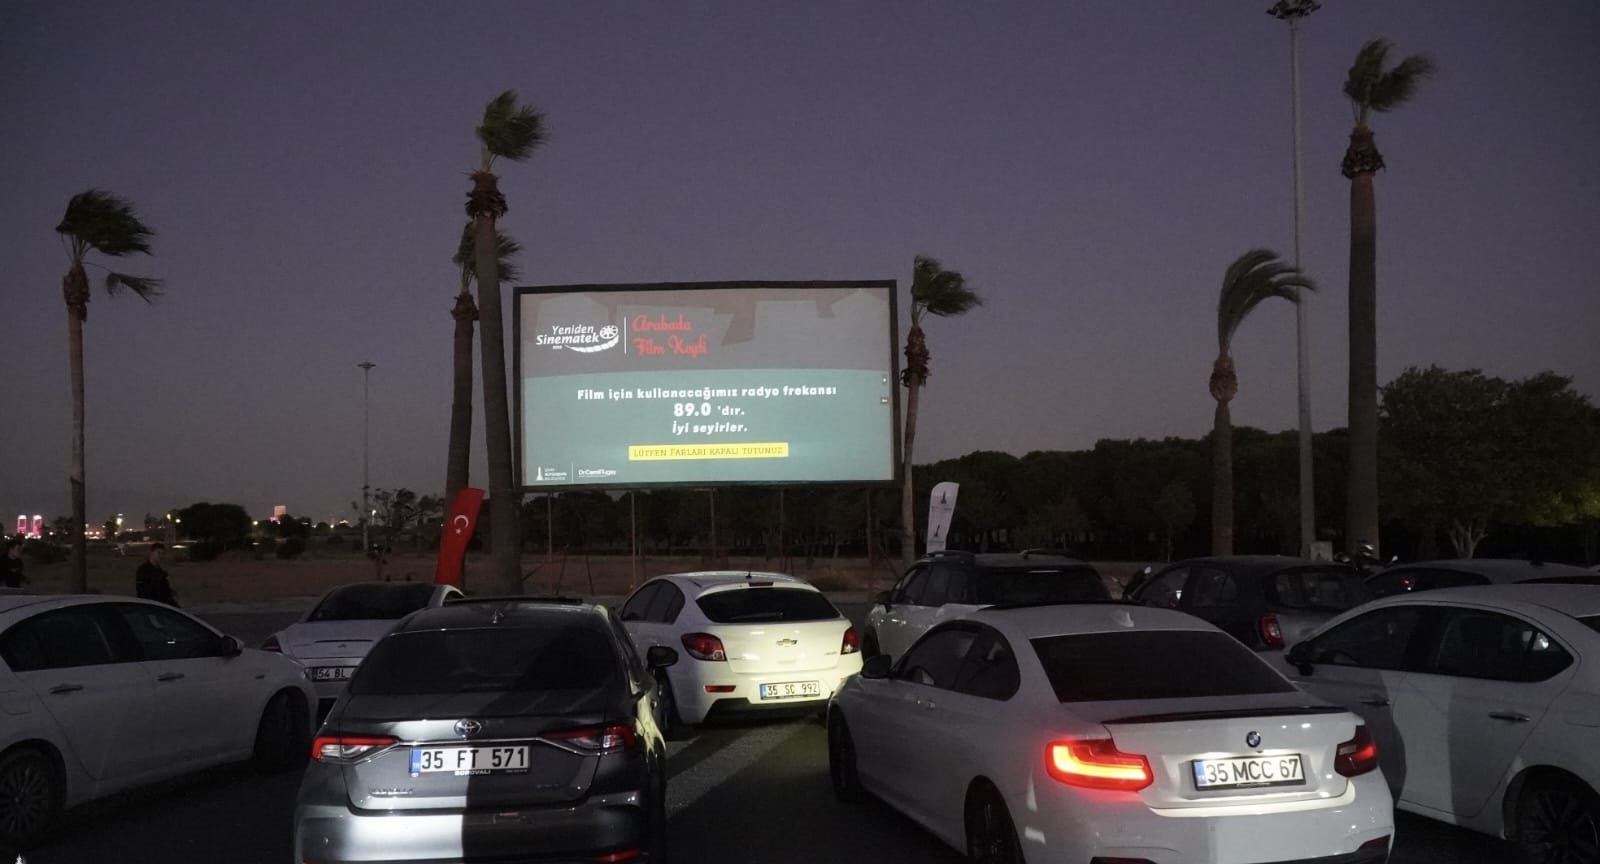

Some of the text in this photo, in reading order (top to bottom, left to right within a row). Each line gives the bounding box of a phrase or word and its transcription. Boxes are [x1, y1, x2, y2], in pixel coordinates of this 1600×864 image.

[552, 324, 594, 335] Yeniden
[632, 314, 692, 332] Arabada
[536, 331, 600, 346] Sinematek
[577, 385, 837, 401] Film için kullanacağımız radyo frekansı
[674, 402, 712, 417] 89.0
[693, 422, 748, 435] seyirler.
[318, 668, 330, 679] 54
[768, 685, 778, 696] 35
[785, 684, 796, 695] SC
[422, 748, 525, 769] 35 FT 571
[1206, 758, 1299, 783] 35 MCC 67
